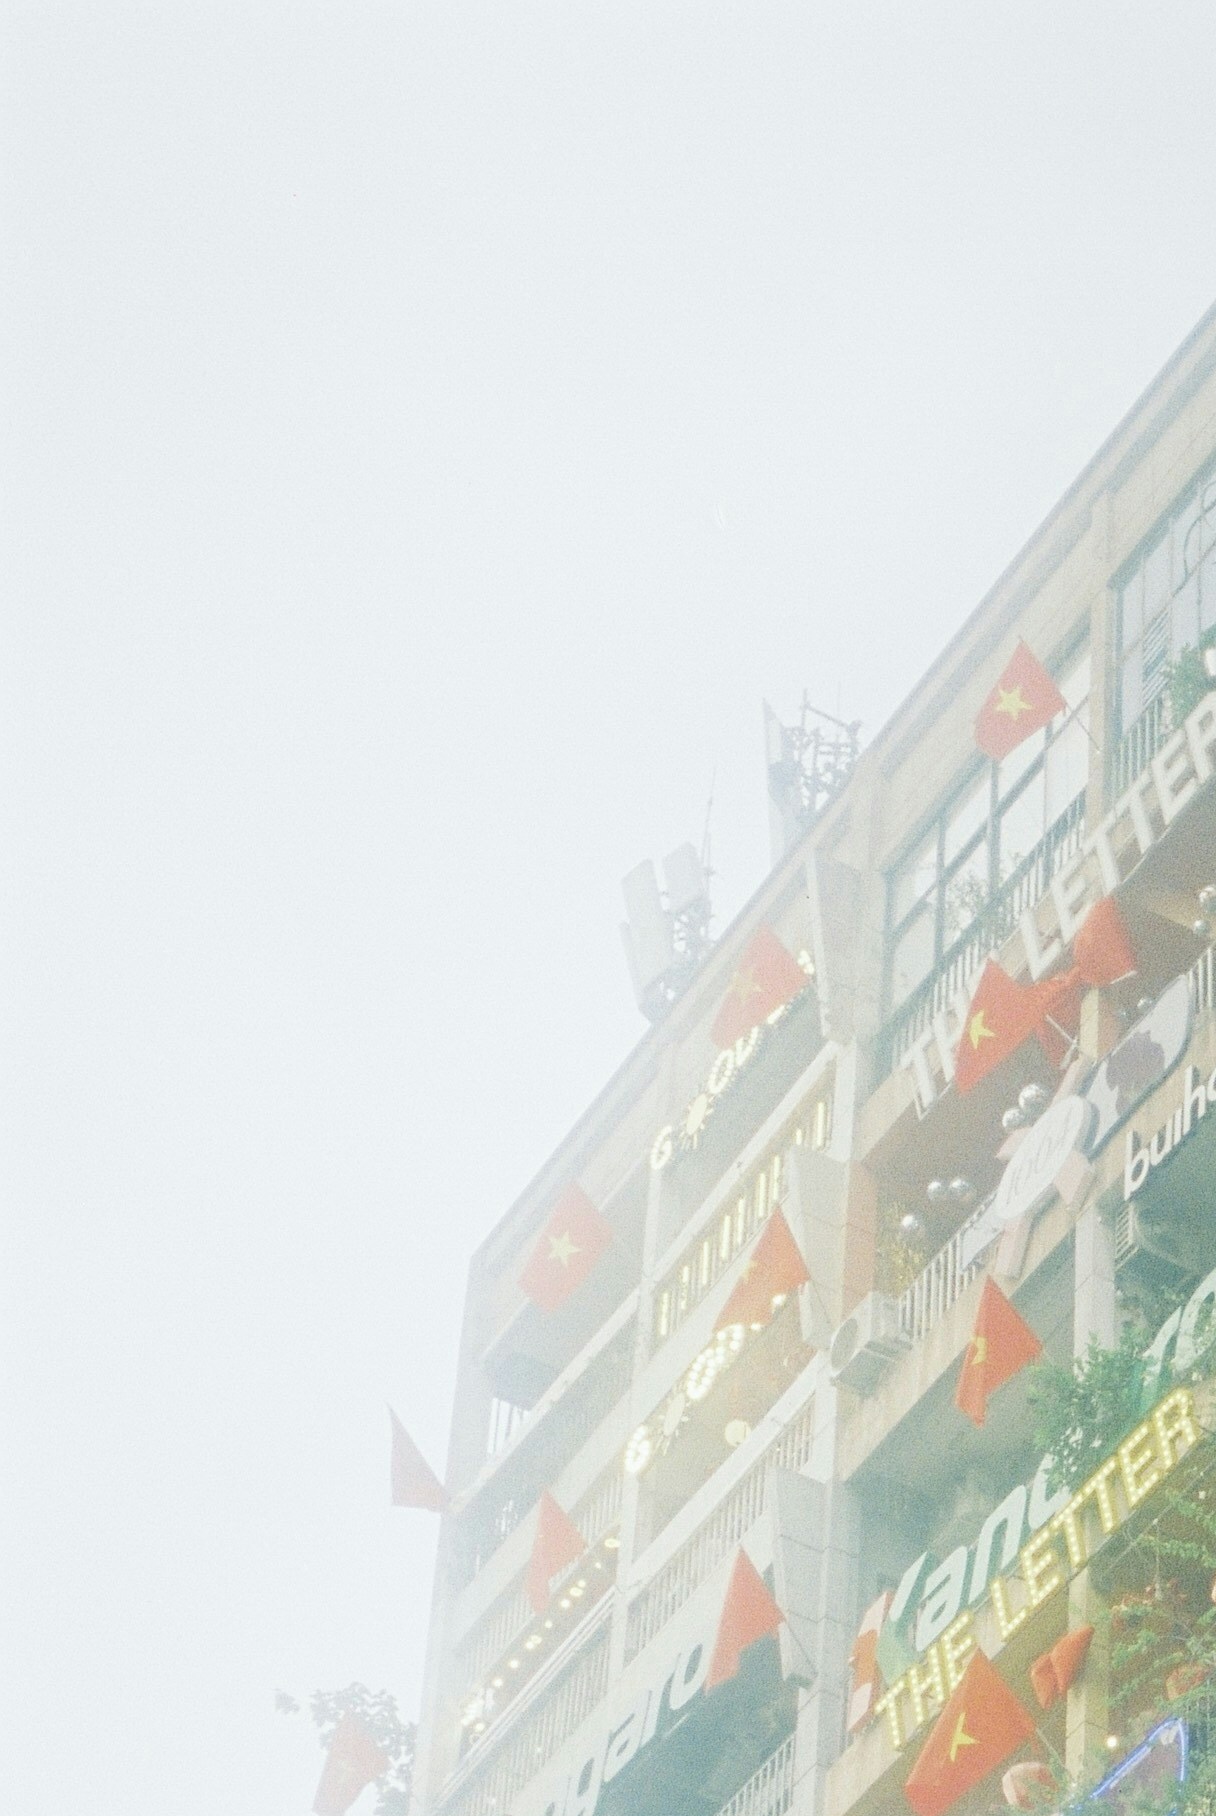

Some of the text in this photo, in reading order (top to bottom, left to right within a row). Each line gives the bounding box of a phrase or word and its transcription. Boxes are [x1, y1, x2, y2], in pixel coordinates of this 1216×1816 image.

[900, 950, 998, 1117] TH
[874, 1386, 1202, 1750] THE LETTER
